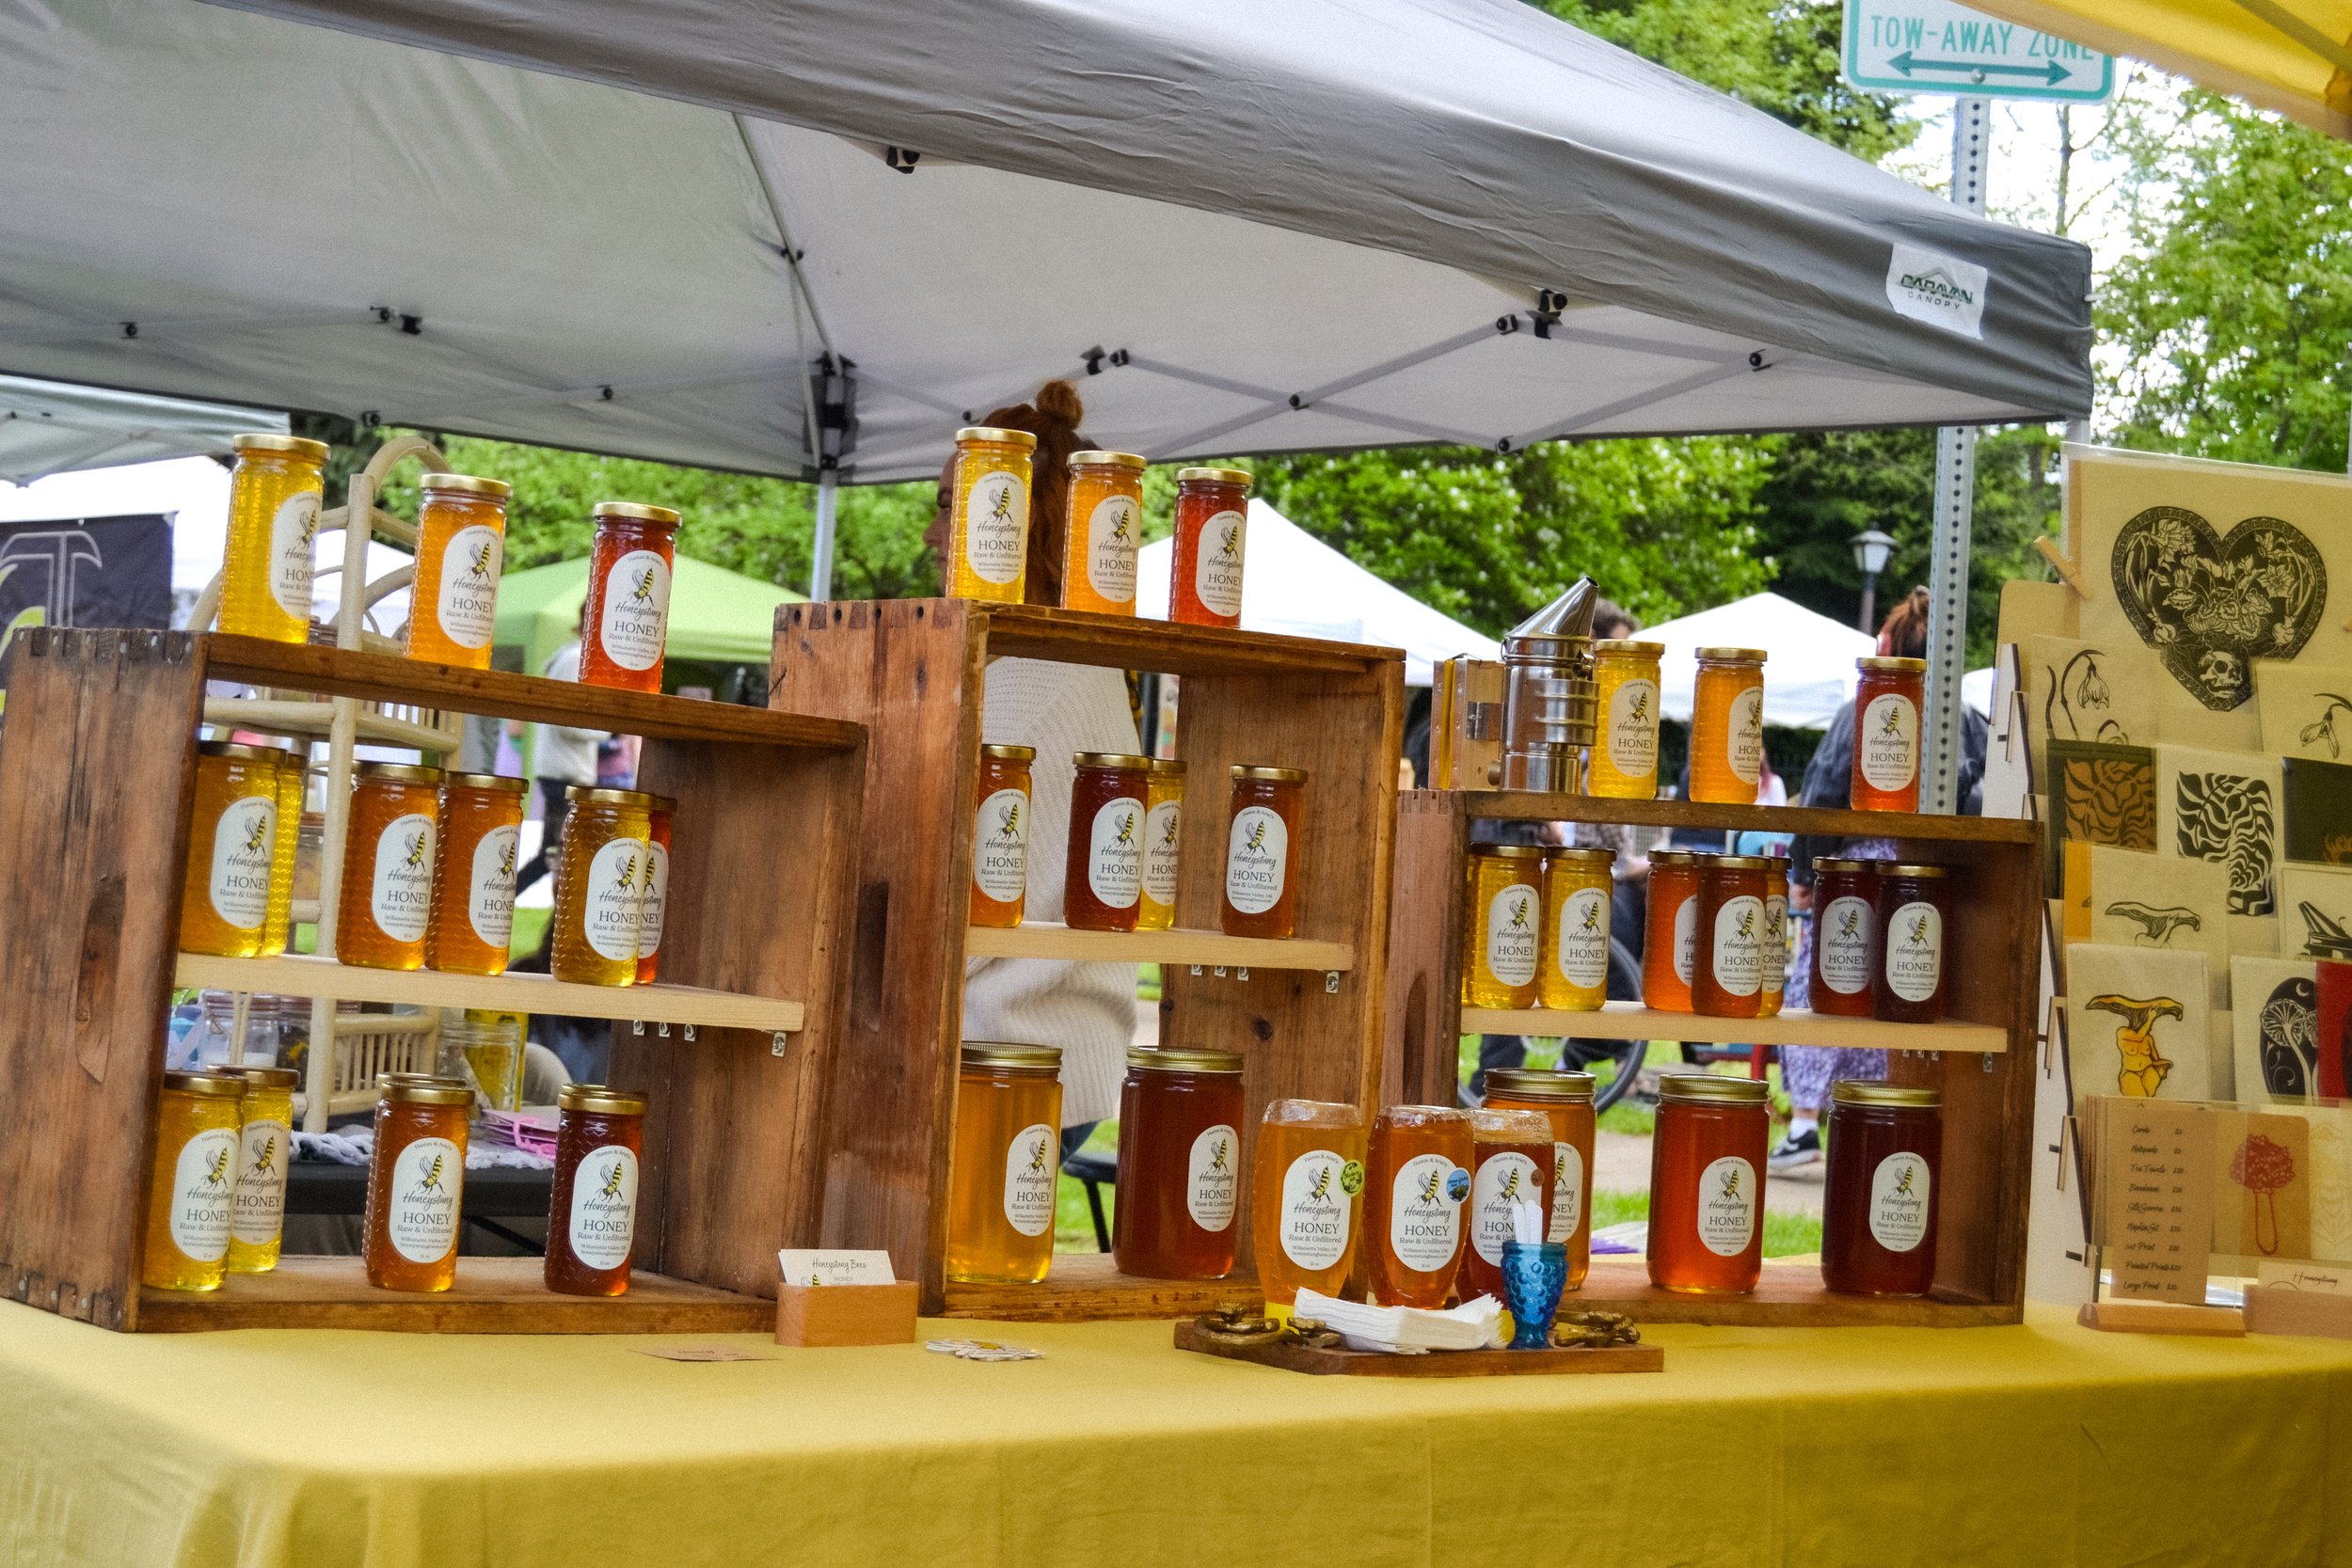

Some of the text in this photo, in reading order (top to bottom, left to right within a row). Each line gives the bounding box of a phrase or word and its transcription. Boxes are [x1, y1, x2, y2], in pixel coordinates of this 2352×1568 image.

[1871, 15, 2013, 55] TOW-AWAY
[1901, 274, 1973, 305] CARAVAN
[1908, 292, 1961, 309] CANOPY
[977, 521, 1021, 539] Honeystung
[978, 540, 1020, 551] HONEY
[1099, 559, 1135, 571] HONEY
[453, 578, 496, 599] Honeystung
[453, 597, 493, 613] HONEY
[615, 601, 661, 625] Honeystung
[614, 621, 660, 638] HONEY
[1618, 721, 1655, 737] Honeystung
[1618, 738, 1654, 749] HONEY
[1870, 735, 1910, 752] Honeystung
[1871, 753, 1909, 762] HONEY
[986, 837, 1025, 856] Honeystung
[1101, 845, 1140, 863] Honeystung
[987, 857, 1024, 868] HONEY
[1234, 851, 1277, 870] Honeystung
[1102, 863, 1138, 875] HONEY
[1233, 870, 1275, 882] HONEY
[227, 876, 269, 890] HONEY
[388, 868, 431, 890] Honeystung
[1248, 882, 1277, 891] Unfiltered
[388, 890, 429, 904] HONEY
[599, 890, 642, 911] Honeystung
[599, 911, 639, 924] HONEY
[642, 913, 660, 924] NEY
[1497, 928, 1535, 944] Honeystung
[1569, 931, 1606, 948] Honeystung
[1498, 946, 1534, 956] HONEY
[1570, 949, 1606, 958] HONEY
[1724, 940, 1761, 955] Honeystung
[1828, 938, 1867, 954] Honeystung
[1896, 944, 1935, 960] Honeystung
[1724, 956, 1760, 966] HONEY
[1829, 955, 1867, 965] HONEY
[1897, 961, 1934, 972] HONEY
[237, 1174, 283, 1194] Honeystung
[1017, 1173, 1052, 1190] Honeystung
[1200, 1171, 1233, 1188] Honeystung
[236, 1196, 281, 1207] HONEY
[403, 1191, 453, 1212] Honeystung
[1017, 1192, 1051, 1202] HONEY
[1200, 1190, 1232, 1199] HONEY
[583, 1198, 630, 1218] Honeystung
[1294, 1201, 1341, 1221] Honeystung
[1553, 1204, 1573, 1212] NEY
[1708, 1198, 1748, 1215] Honeystung
[1882, 1195, 1921, 1212] Honeystung
[187, 1210, 230, 1222] HONEY
[404, 1212, 452, 1225] HONEY
[1404, 1205, 1451, 1224] Honeystung
[1709, 1216, 1747, 1226] HONEY
[1882, 1212, 1919, 1223] HONEY
[584, 1220, 628, 1232] HONEY
[1295, 1222, 1340, 1234] HONEY
[1406, 1225, 1450, 1236] HONEY
[1485, 1222, 1514, 1232] HON
[813, 1258, 866, 1273] Honeystung Bees
